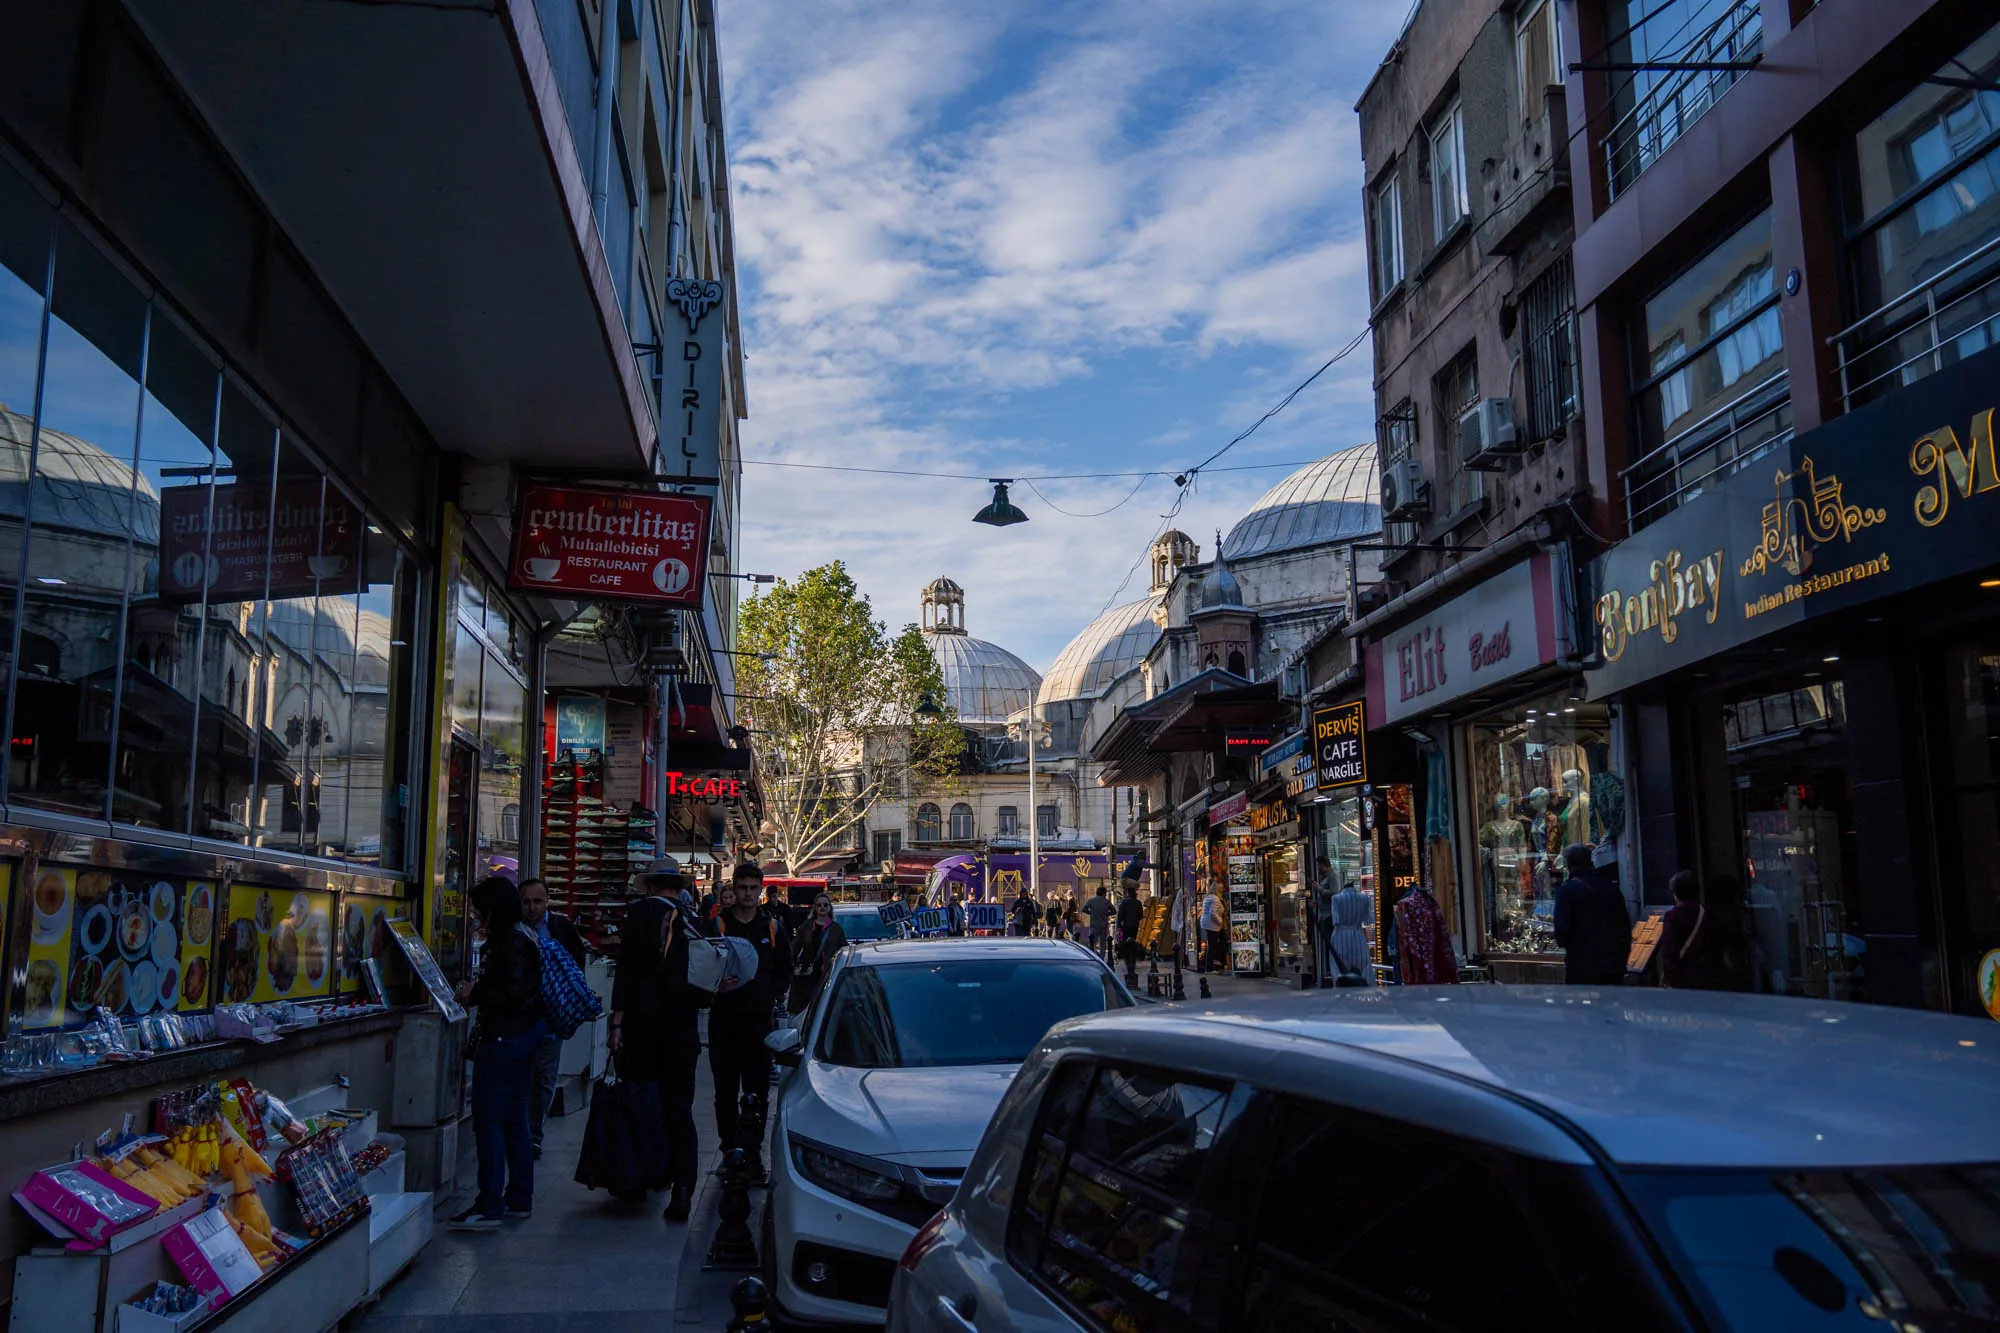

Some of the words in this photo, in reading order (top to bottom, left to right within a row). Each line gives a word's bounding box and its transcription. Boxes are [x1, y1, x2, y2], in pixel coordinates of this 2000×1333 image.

[560, 535, 660, 557] Muhallebicisi
[567, 556, 648, 573] RESTAURANT
[589, 574, 622, 586] CAFE
[1745, 591, 1784, 619] Indian
[1784, 551, 1892, 604] Restaurant
[1595, 549, 1725, 662] Bombay
[1397, 626, 1448, 703] Elit
[1317, 714, 1360, 740] DERVİŞ
[1323, 740, 1357, 761] CAFE
[1321, 761, 1362, 783] NARGİLE
[690, 779, 741, 797] CAFE
[1286, 779, 1303, 798] GOLD
[1269, 799, 1288, 828] USTA
[880, 904, 904, 924] 200
[919, 911, 941, 930] 100
[970, 907, 997, 926] 200
